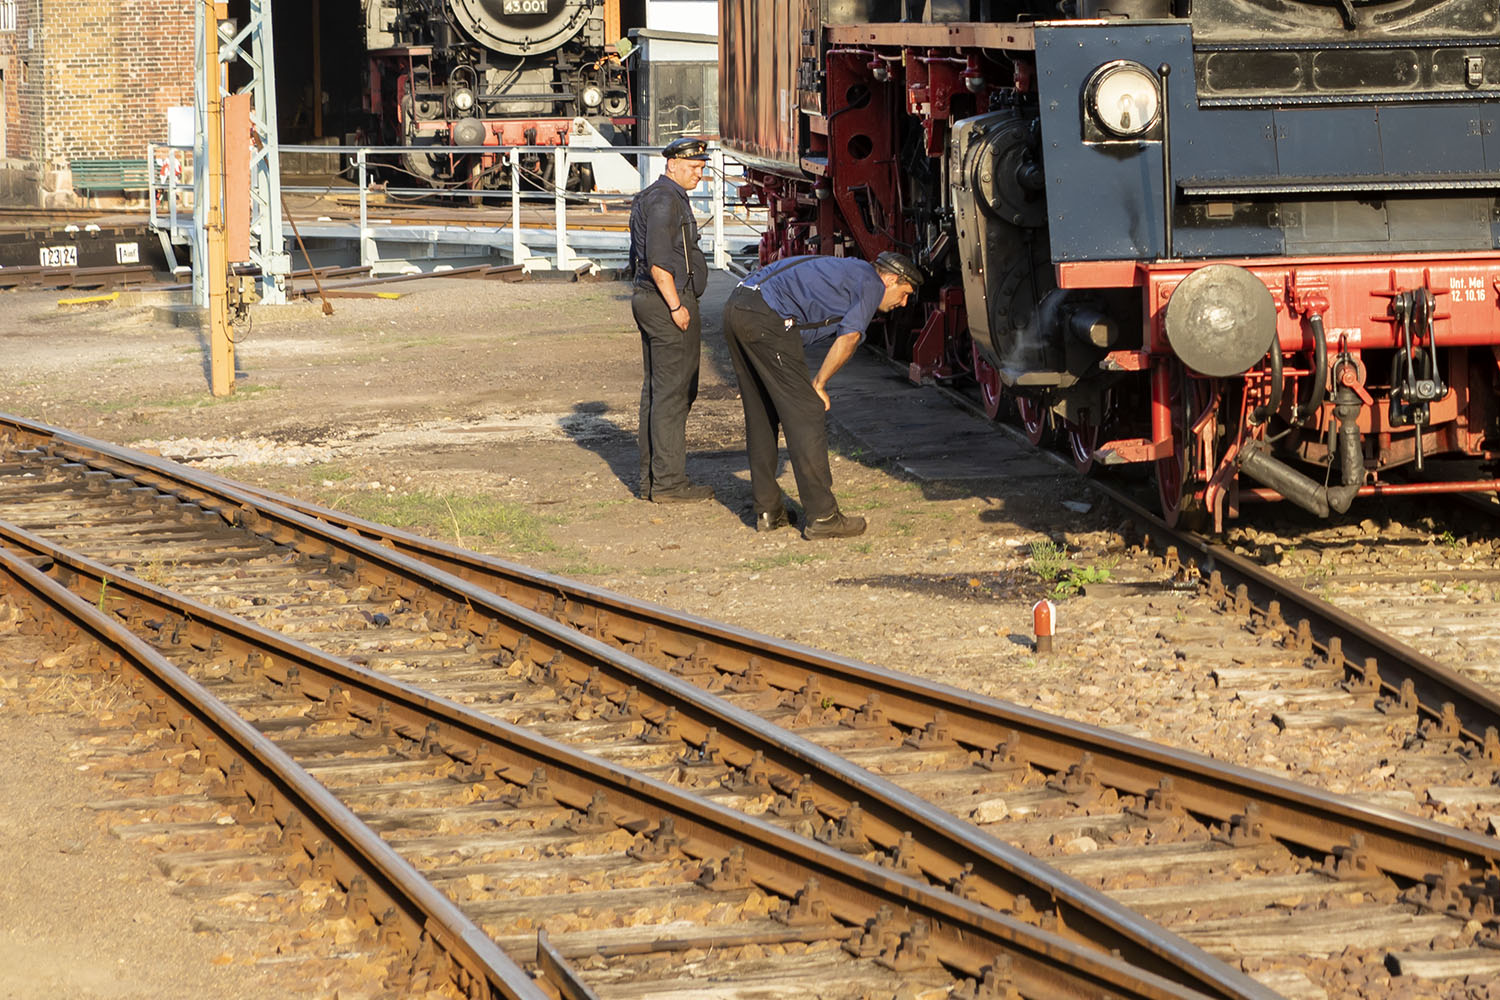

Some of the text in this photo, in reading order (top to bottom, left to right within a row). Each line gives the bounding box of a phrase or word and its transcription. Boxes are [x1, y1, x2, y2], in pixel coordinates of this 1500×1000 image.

[522, 0, 545, 12] 001
[1450, 276, 1484, 289] Unt. Mei
[1451, 289, 1486, 302] 12. 10.16
